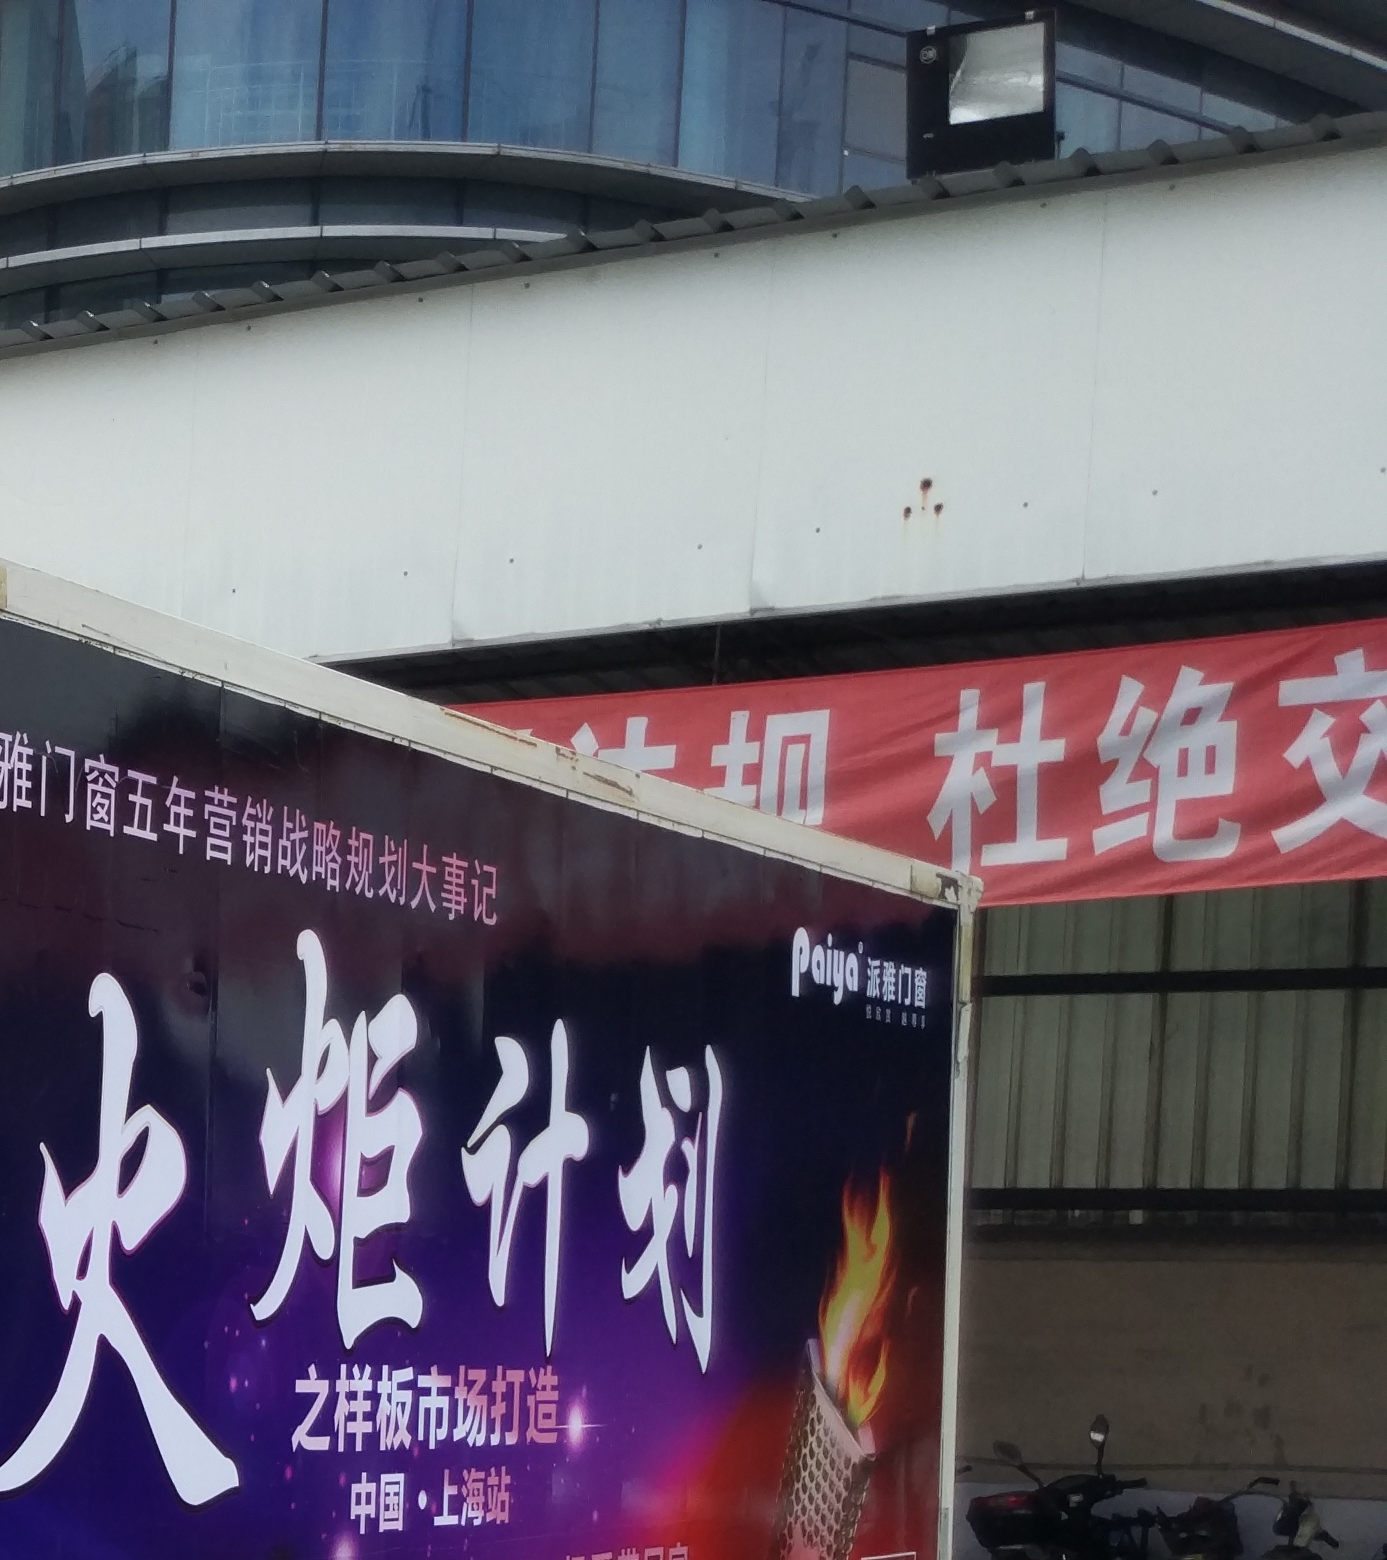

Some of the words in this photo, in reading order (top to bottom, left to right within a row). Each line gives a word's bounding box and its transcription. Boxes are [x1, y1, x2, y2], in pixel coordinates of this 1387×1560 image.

[866, 957, 927, 1009] 派雅门窗
[291, 1363, 560, 1452] 之样板市场打造
